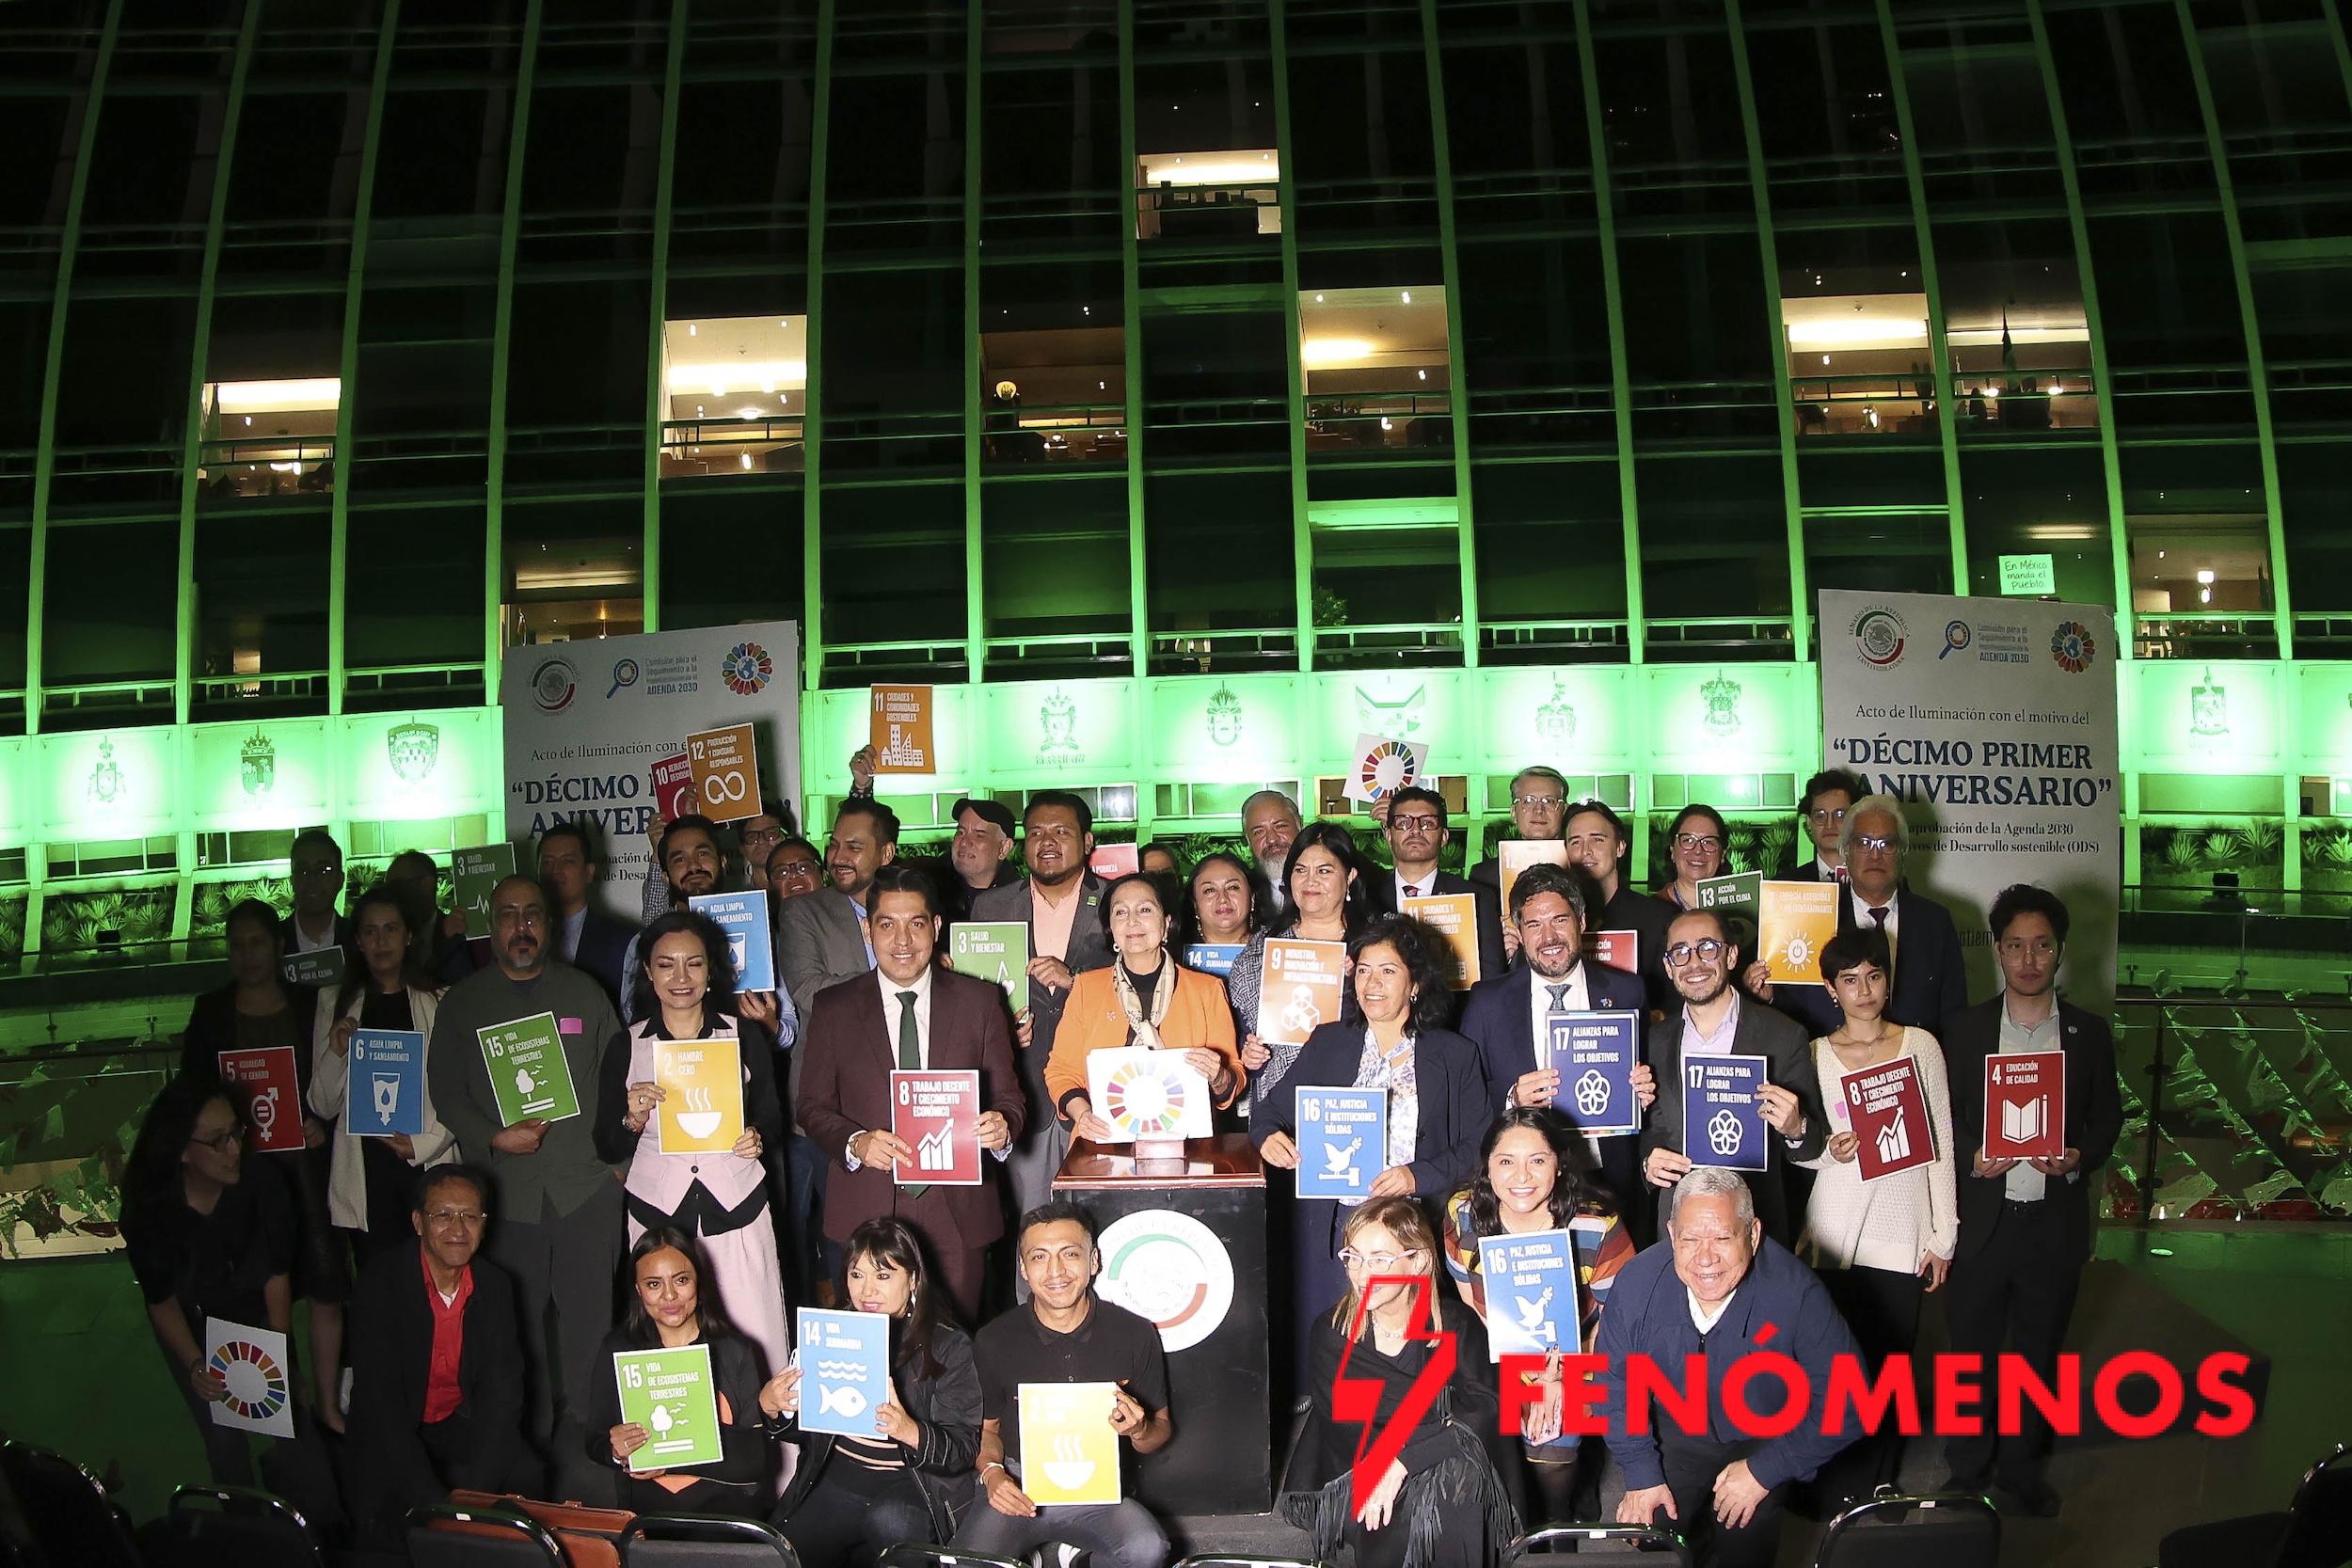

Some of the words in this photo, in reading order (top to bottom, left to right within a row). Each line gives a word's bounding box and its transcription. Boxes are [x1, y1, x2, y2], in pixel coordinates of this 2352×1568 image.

[2005, 561, 2017, 571] En
[2020, 559, 2047, 570] México
[2011, 579, 2044, 590] pueblo
[1979, 652, 2009, 662] AGENDA
[2011, 653, 2029, 663] 2030
[647, 684, 676, 695] AGENDA
[678, 683, 698, 693] 2030
[875, 692, 884, 712] 11
[1856, 705, 1886, 718] Acto
[1889, 705, 1905, 719] de
[1910, 705, 1984, 721] Iluminación
[1989, 711, 2012, 721] con
[2015, 708, 2026, 722] el
[2029, 710, 2070, 724] motivo
[2073, 711, 2090, 726] del
[531, 748, 560, 762] Acto
[561, 745, 574, 759] de
[579, 741, 652, 758] Iluminación
[656, 740, 677, 752] con
[681, 742, 687, 751] e
[691, 740, 706, 761] 12
[1834, 733, 1973, 767] “DÉCIMO
[1982, 742, 2093, 769] PRIMER
[656, 767, 669, 785] 10
[512, 772, 640, 804] “DÉCIMO
[1975, 821, 1989, 834] de
[1991, 822, 2001, 834] la
[2004, 822, 2045, 837] Agenda
[2047, 823, 2074, 835] 2030
[1933, 839, 1947, 852] de
[1949, 839, 2009, 853] Desarrollo
[2010, 841, 2066, 854] sostenible
[2067, 840, 2100, 855] (ODS)
[458, 856, 466, 876] 3
[1718, 883, 1736, 895] ACCIÓN
[1701, 887, 1715, 908] 13
[1719, 895, 1729, 906] POR
[1730, 895, 1736, 904] EL
[1736, 893, 1752, 903] CLIMA
[710, 904, 726, 913] AGUA
[726, 901, 745, 912] LIMPIA
[716, 912, 754, 925] SANEAMIENTO
[959, 931, 967, 954] 3
[971, 931, 990, 942] SALUD
[971, 943, 976, 953] Y
[976, 942, 1005, 953] BIENESTAR
[1188, 951, 1203, 967] 14
[1272, 947, 1281, 971] 9
[504, 1031, 518, 1042] VIDA
[1554, 1026, 1570, 1051] 17
[1573, 1026, 1601, 1037] ALIANZAS
[1602, 1026, 1619, 1037] PARA
[356, 1038, 365, 1060] 6
[370, 1039, 384, 1049] AGUA
[385, 1039, 404, 1050] LIMPIA
[486, 1036, 504, 1058] 15
[508, 1044, 516, 1054] DE
[516, 1036, 551, 1053] ECOSISTEMAS
[1573, 1039, 1598, 1051] LOGRAR
[373, 1053, 410, 1062] SANEAMIENTO
[511, 1050, 544, 1066] TERRESTRES
[663, 1052, 673, 1076] 2
[678, 1050, 705, 1062] HAMBRE
[1573, 1053, 1585, 1064] LOS
[1586, 1053, 1619, 1063] OBJETIVOS
[227, 1061, 236, 1082] 5
[678, 1065, 695, 1076] CERO
[1707, 1066, 1735, 1077] ALIANZAS
[1735, 1067, 1752, 1078] PARA
[1992, 1064, 2002, 1085] 4
[2006, 1060, 2039, 1073] EDUCACIÓN
[1689, 1065, 1704, 1089] 17
[1707, 1079, 1730, 1090] LOGRAR
[1860, 1073, 1886, 1090] TRABAJO
[1886, 1066, 1911, 1083] DECENTE
[2006, 1075, 2013, 1085] DE
[2014, 1074, 2039, 1085] CALIDAD
[899, 1081, 910, 1106] 8
[912, 1081, 942, 1092] TRABAJO
[943, 1081, 971, 1092] DECENTE
[1850, 1082, 1862, 1106] 8
[1863, 1091, 1868, 1102] Y
[1868, 1081, 1905, 1101] CRECIMIENTO
[913, 1093, 918, 1104] Y
[918, 1093, 961, 1105] CRECIMIENTO
[1325, 1099, 1339, 1110] PAZ,
[1340, 1099, 1368, 1110] JUSTICIA
[1707, 1092, 1719, 1102] LOS
[1720, 1092, 1752, 1104] OBJETIVOS
[1866, 1095, 1899, 1115] ECONÓMICO
[913, 1104, 950, 1117] ECONÓMICO
[1302, 1098, 1321, 1122] 16
[1325, 1112, 1329, 1122] E
[1330, 1112, 1377, 1122] INSTITUCIONES
[1325, 1123, 1353, 1135] SÓLIDAS
[1510, 1246, 1524, 1259] PAZ,
[1525, 1243, 1553, 1257] JUSTICIA
[1486, 1247, 1507, 1275] 16
[1512, 1261, 1517, 1273] E
[1517, 1257, 1565, 1272] INSTITUCIONES
[1514, 1273, 1542, 1287] SÓLIDAS
[803, 1320, 821, 1347] 14
[645, 1362, 662, 1372] VIDA
[623, 1363, 643, 1388] 15
[648, 1376, 658, 1386] DE
[658, 1371, 699, 1386] ECOSISTEMAS
[649, 1386, 688, 1401] TERRESTRES
